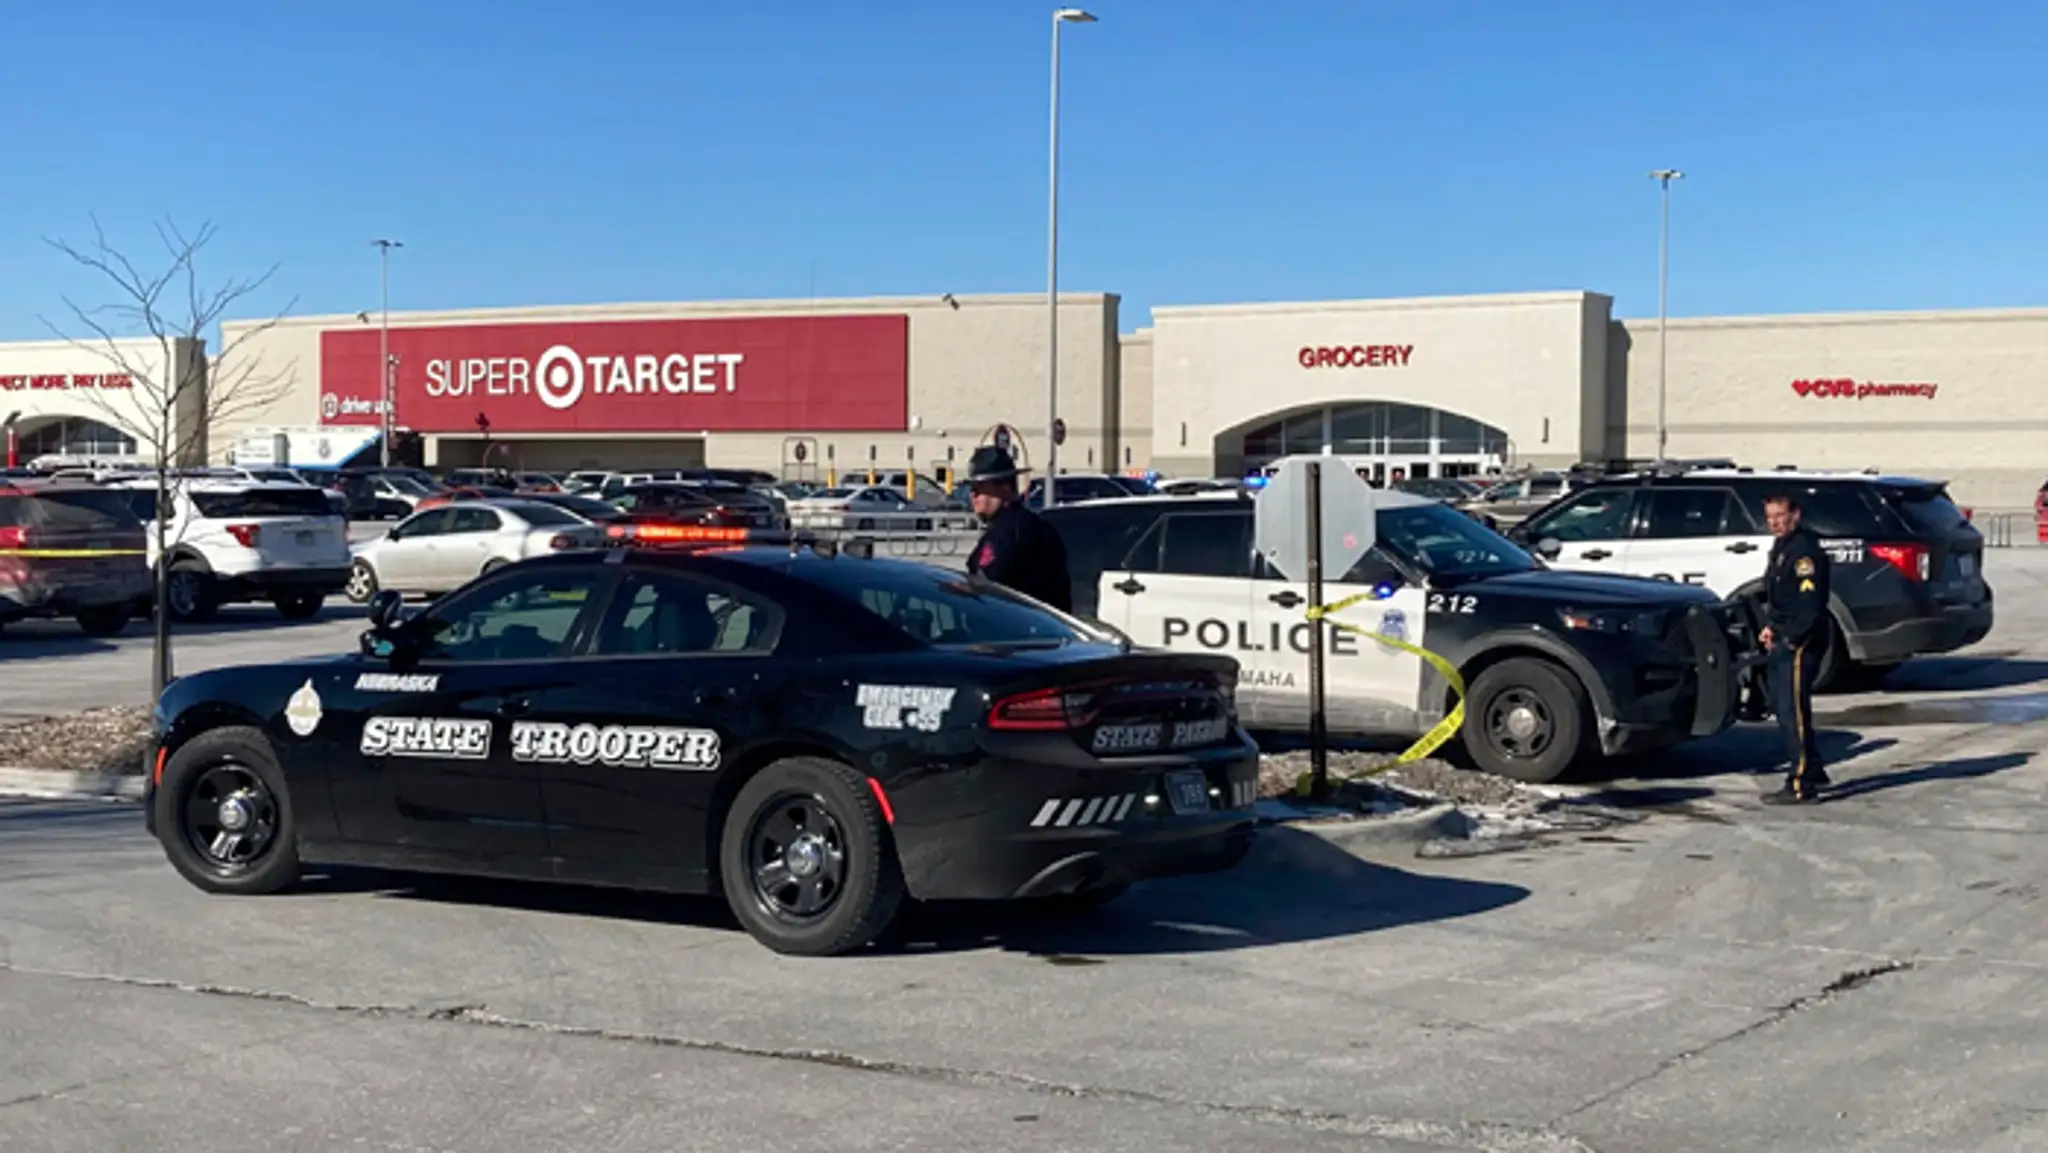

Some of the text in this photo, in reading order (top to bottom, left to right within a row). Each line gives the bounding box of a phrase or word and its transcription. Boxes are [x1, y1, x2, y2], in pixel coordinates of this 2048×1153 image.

[1298, 344, 1414, 369] GROCERY
[425, 353, 744, 396] SUPER TARGET
[1811, 378, 1938, 400] CVS pharmacy
[1427, 593, 1479, 613] 212
[1162, 616, 1359, 656] POLICE
[1239, 670, 1296, 688] MAHA
[360, 716, 721, 770] STATE TROOPER
[1092, 724, 1162, 752] STATE
